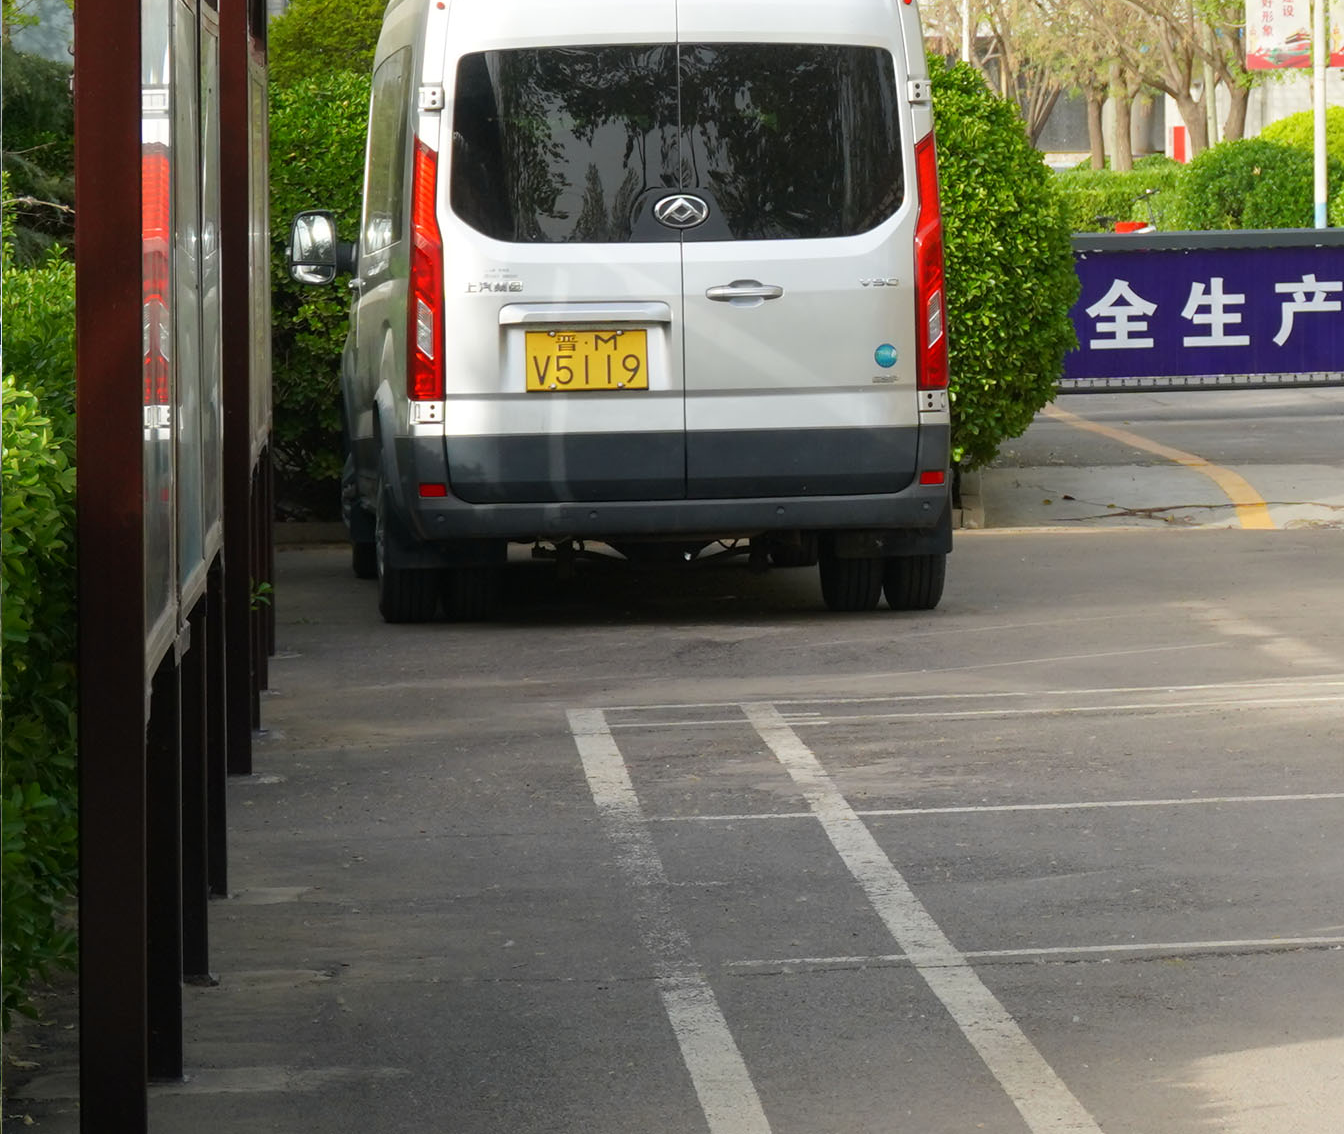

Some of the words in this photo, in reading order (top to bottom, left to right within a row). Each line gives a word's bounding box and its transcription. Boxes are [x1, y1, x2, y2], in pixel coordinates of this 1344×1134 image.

[1085, 272, 1344, 350] 全生产
[532, 353, 641, 386] V5119
